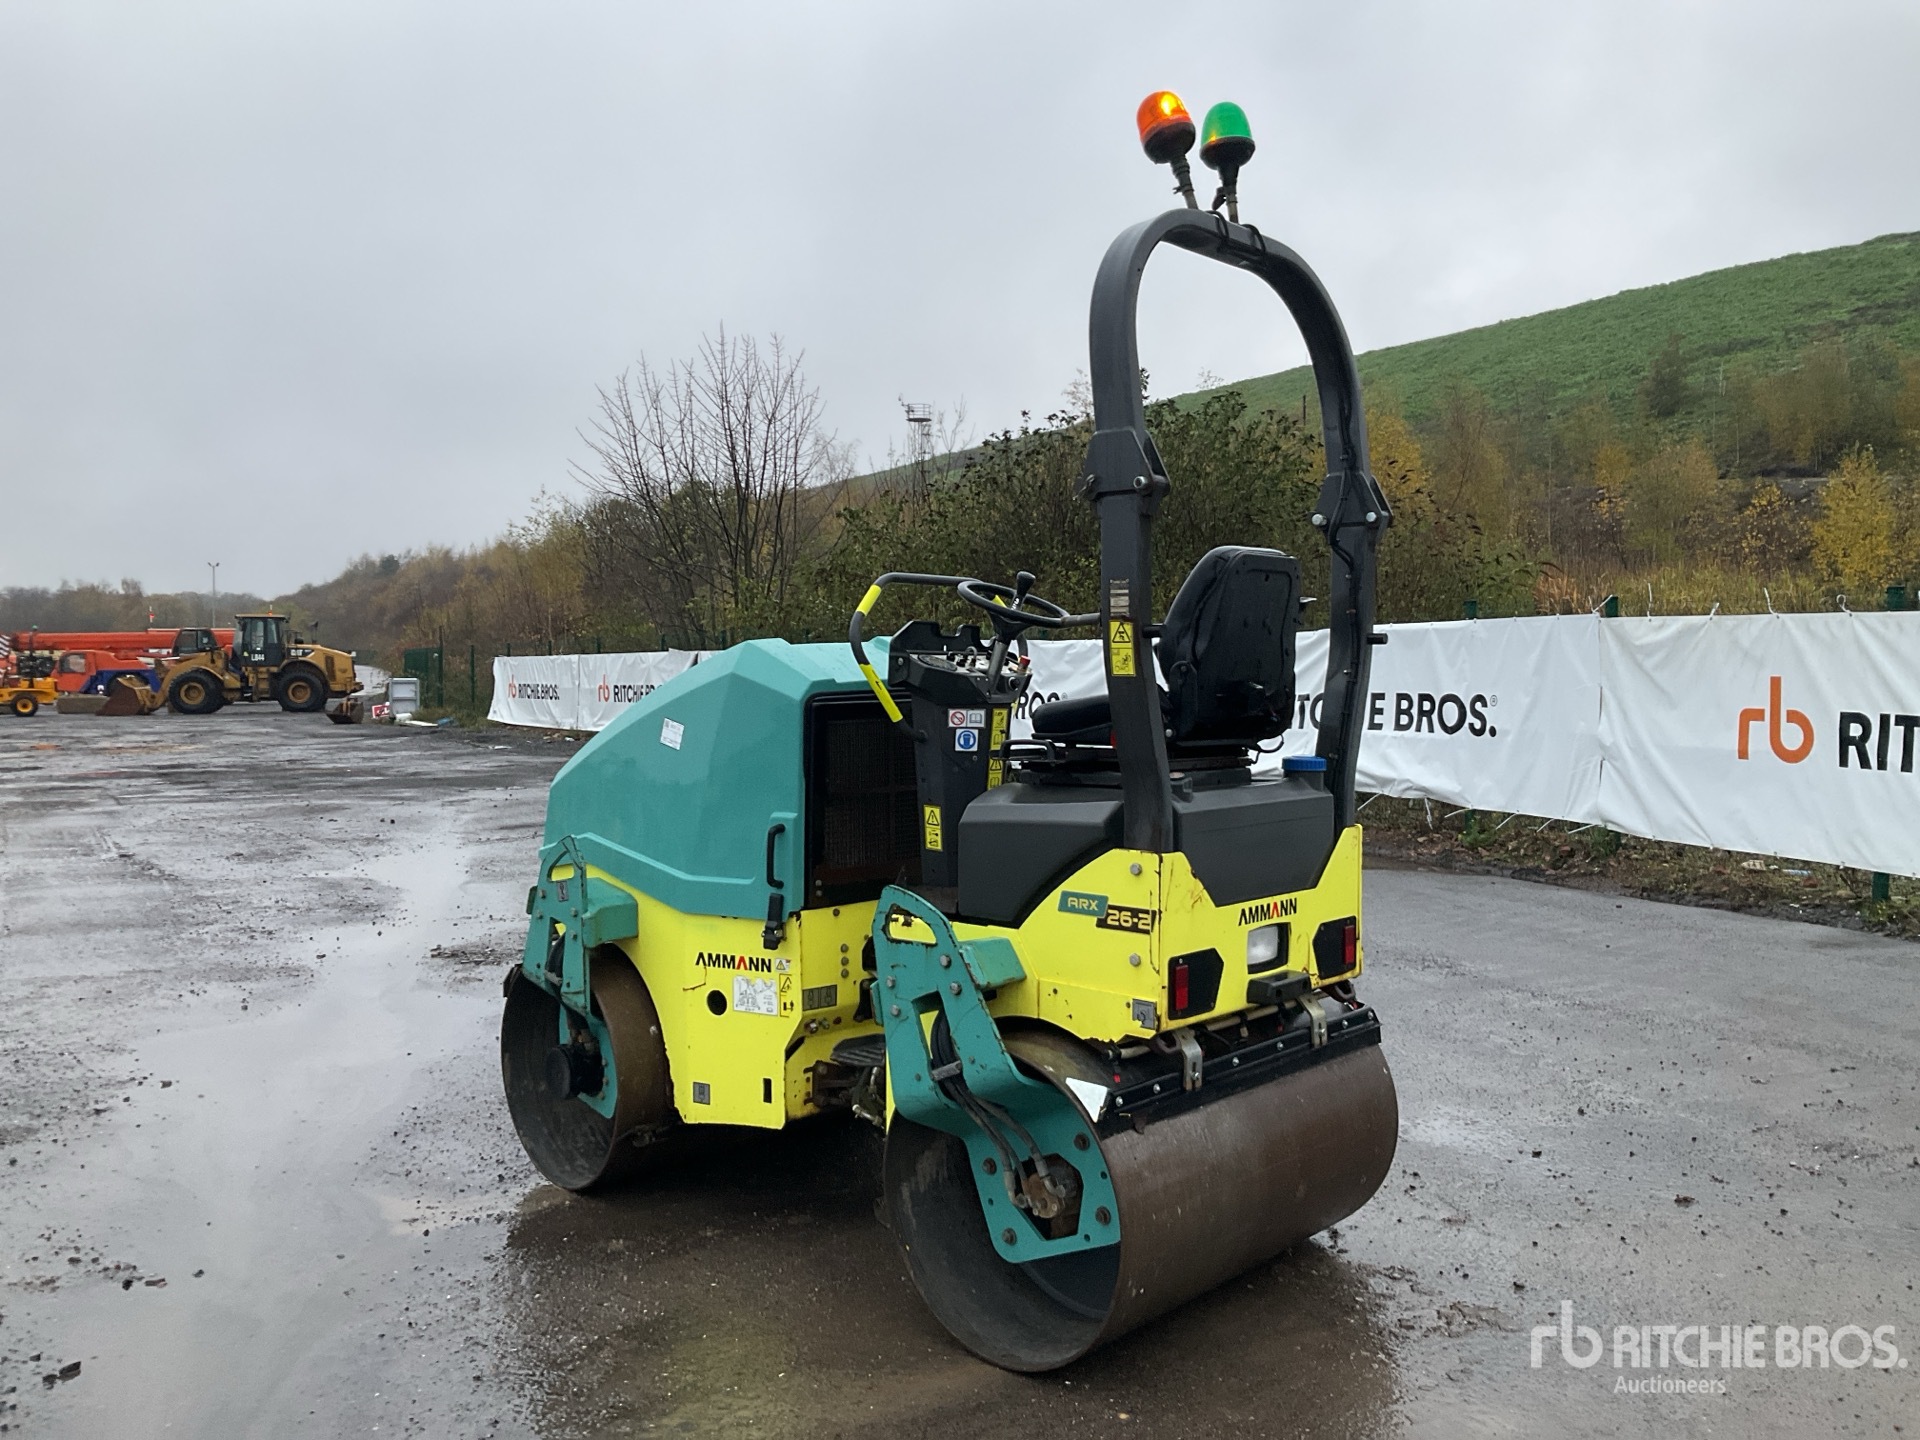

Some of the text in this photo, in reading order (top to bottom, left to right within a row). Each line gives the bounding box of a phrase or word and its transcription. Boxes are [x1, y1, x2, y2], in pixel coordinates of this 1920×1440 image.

[518, 683, 541, 700] RITCHIE
[1737, 675, 1815, 764] rb
[1067, 896, 1151, 931] ARX 26-2
[1238, 897, 1297, 926] AMMANN
[695, 952, 772, 973] AMMANN
